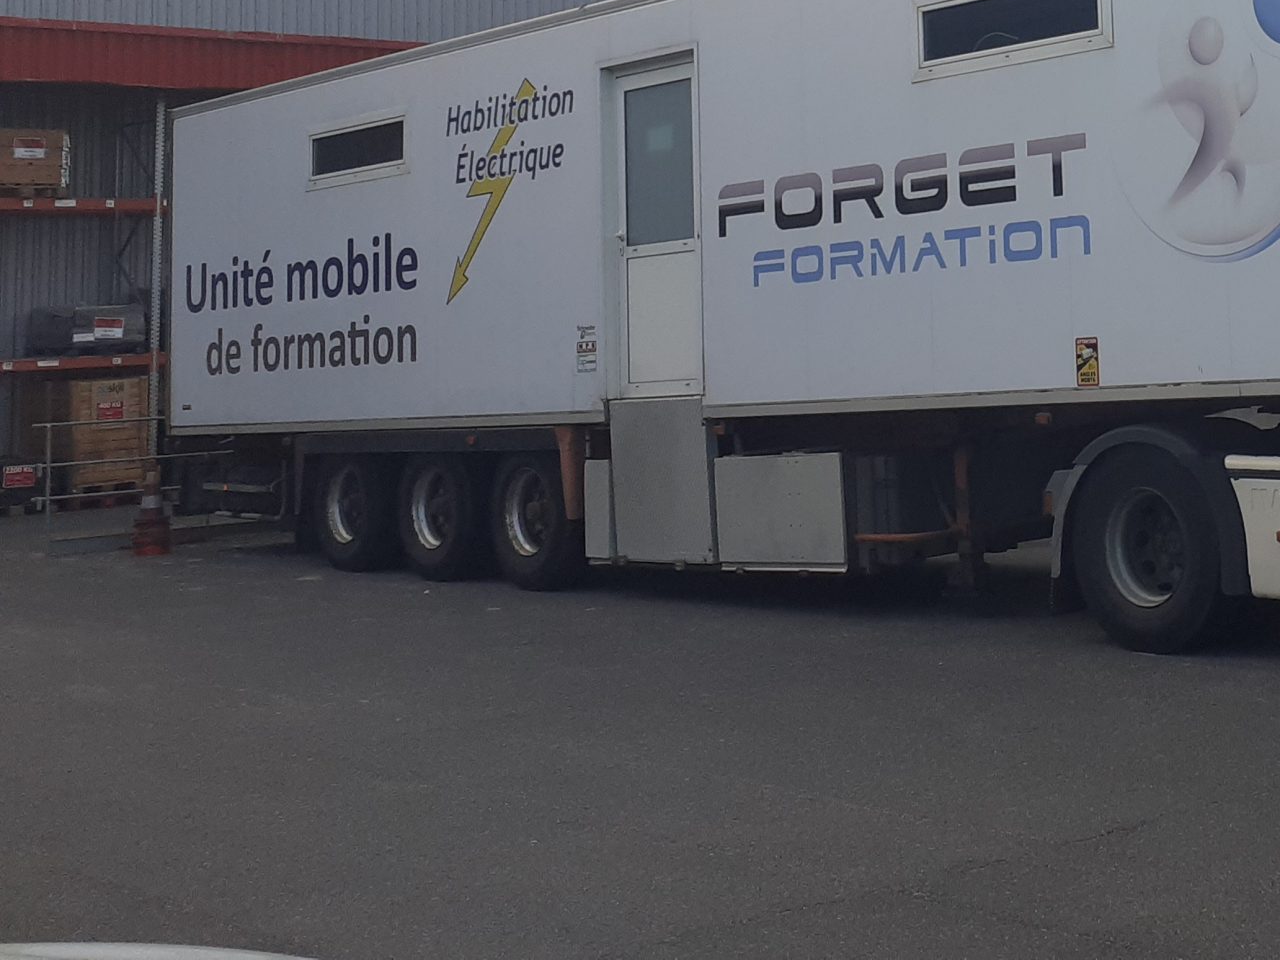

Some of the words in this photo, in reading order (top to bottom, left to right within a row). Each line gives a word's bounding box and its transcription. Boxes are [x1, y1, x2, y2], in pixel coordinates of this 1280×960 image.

[446, 85, 574, 137] Habilitation
[456, 140, 564, 184] Électrique
[718, 132, 1087, 238] FORGET
[186, 249, 274, 313] Unité
[286, 232, 418, 302] mobile
[206, 328, 241, 376] de
[251, 314, 417, 372] formation
